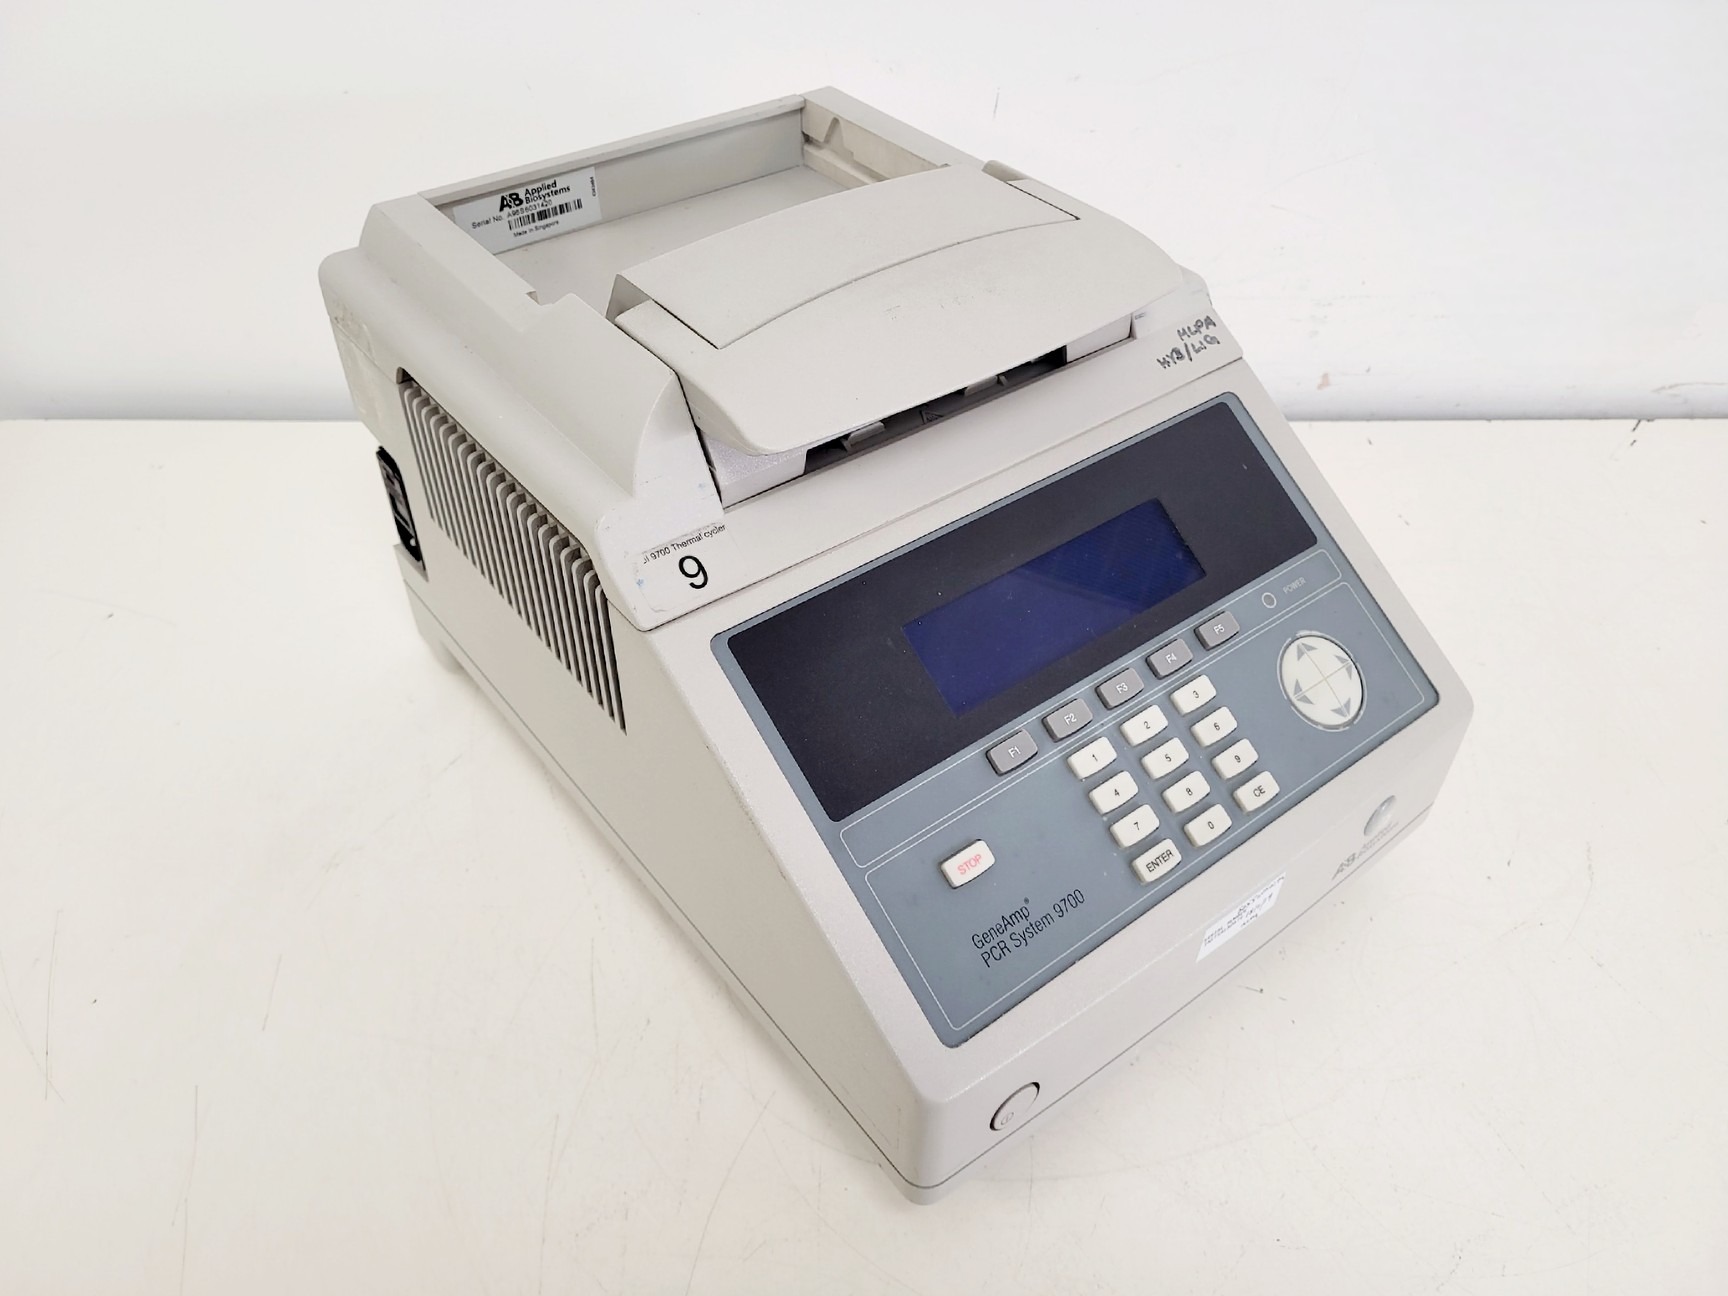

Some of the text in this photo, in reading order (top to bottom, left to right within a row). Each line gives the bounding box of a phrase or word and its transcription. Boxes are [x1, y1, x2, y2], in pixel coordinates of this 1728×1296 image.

[525, 179, 557, 197] Applied
[525, 185, 571, 205] Biosystems
[471, 217, 492, 230] Serial
[513, 229, 527, 238] Made
[534, 220, 560, 232] Singapore
[650, 546, 671, 560] 9700
[671, 532, 703, 552] Thermal
[703, 524, 726, 538] cycler
[678, 555, 708, 589] 9
[1283, 577, 1306, 594] POWER
[1214, 624, 1225, 635] F5
[1165, 652, 1177, 665] F4
[1116, 682, 1128, 694] F3
[1192, 690, 1200, 699] 3
[1064, 712, 1077, 726] F2
[1143, 721, 1151, 730] 2
[1213, 722, 1221, 731] 6
[1008, 745, 1021, 759] F1
[1092, 753, 1098, 762] 1
[1164, 754, 1172, 762] 5
[1234, 755, 1241, 763] 9
[1113, 789, 1120, 797] 4
[1186, 787, 1193, 796] 8
[1253, 785, 1266, 798] CE
[1133, 821, 1140, 830] 7
[1207, 820, 1215, 829] 0
[957, 854, 982, 875] STOP
[1145, 849, 1174, 873] ENTER
[980, 889, 1085, 968] PCR System 9700
